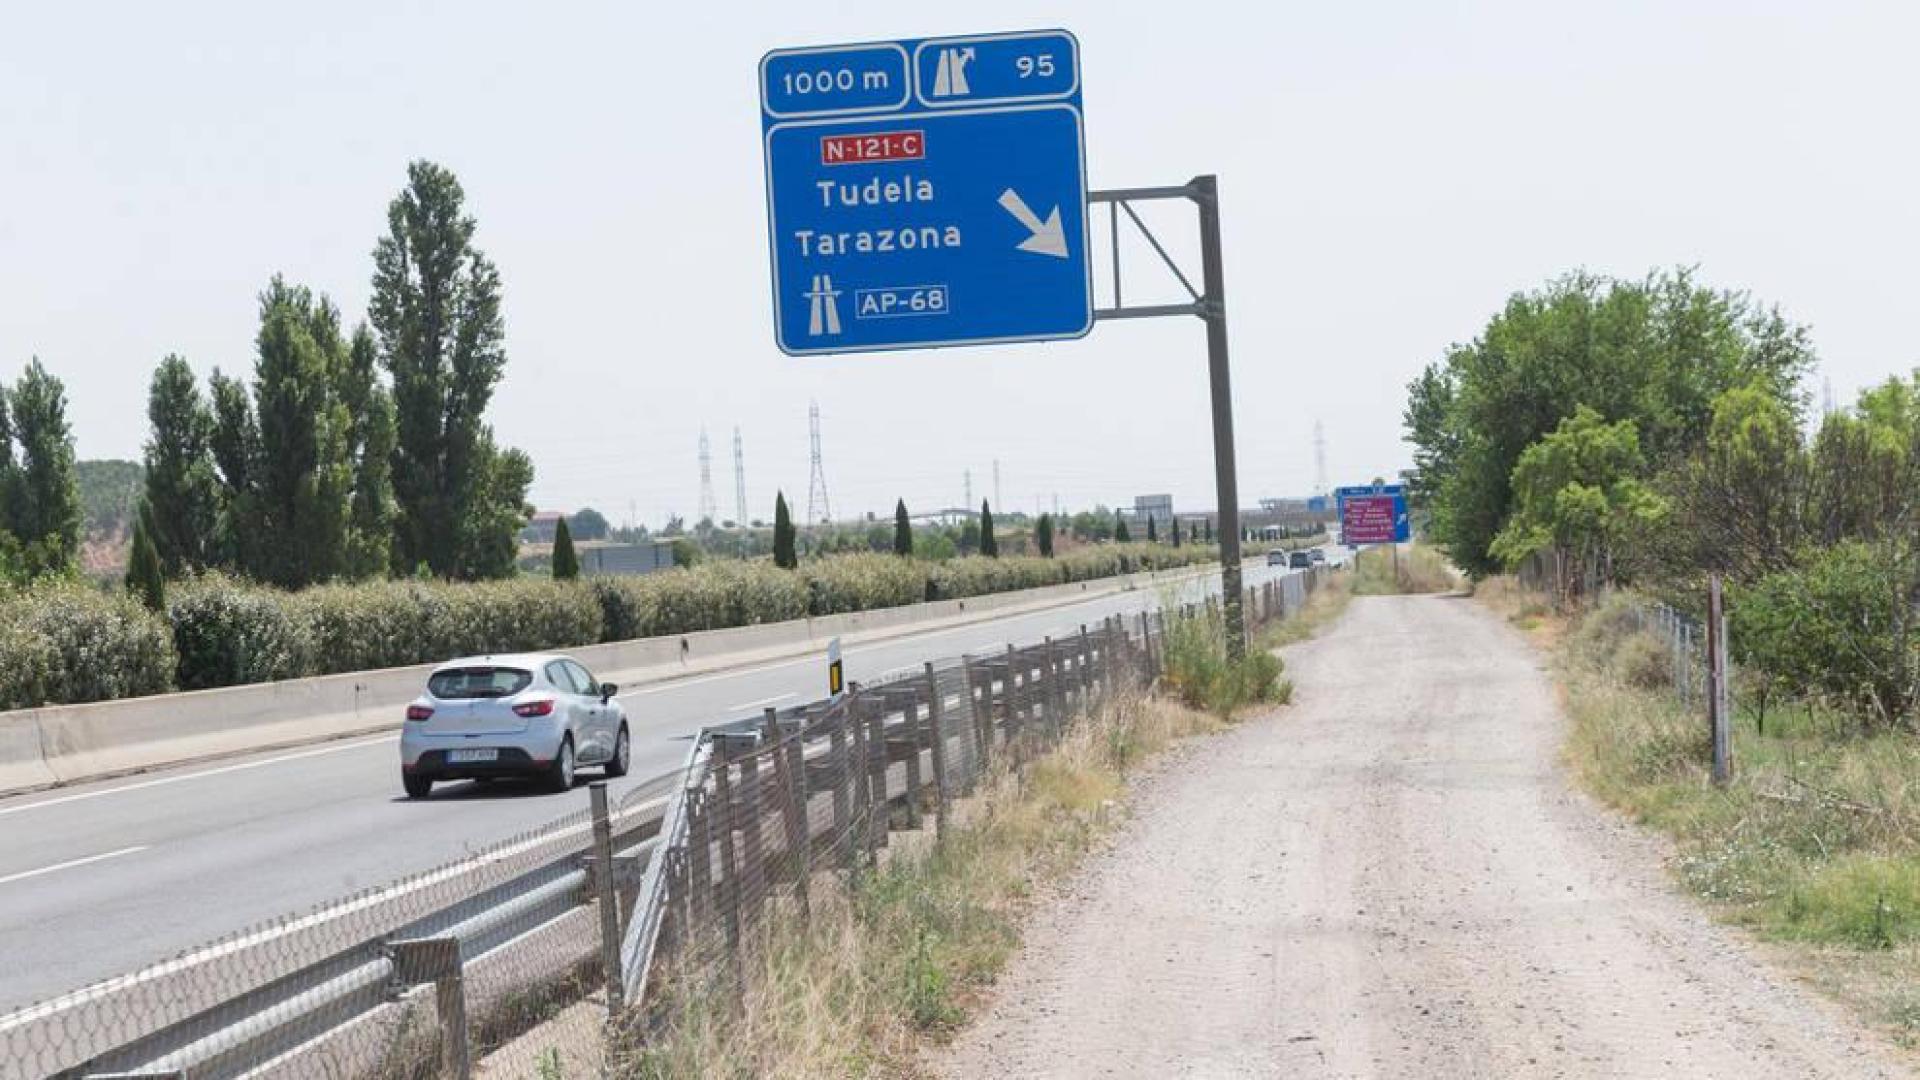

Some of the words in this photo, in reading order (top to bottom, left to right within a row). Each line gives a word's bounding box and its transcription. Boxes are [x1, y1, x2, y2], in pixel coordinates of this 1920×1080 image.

[1016, 54, 1055, 78] 95
[782, 69, 854, 95] 1000
[863, 70, 888, 90] m
[827, 135, 918, 161] N-121-C
[816, 175, 934, 207] Tudela
[795, 225, 961, 257] Tarazona
[861, 290, 944, 315] AP-68
